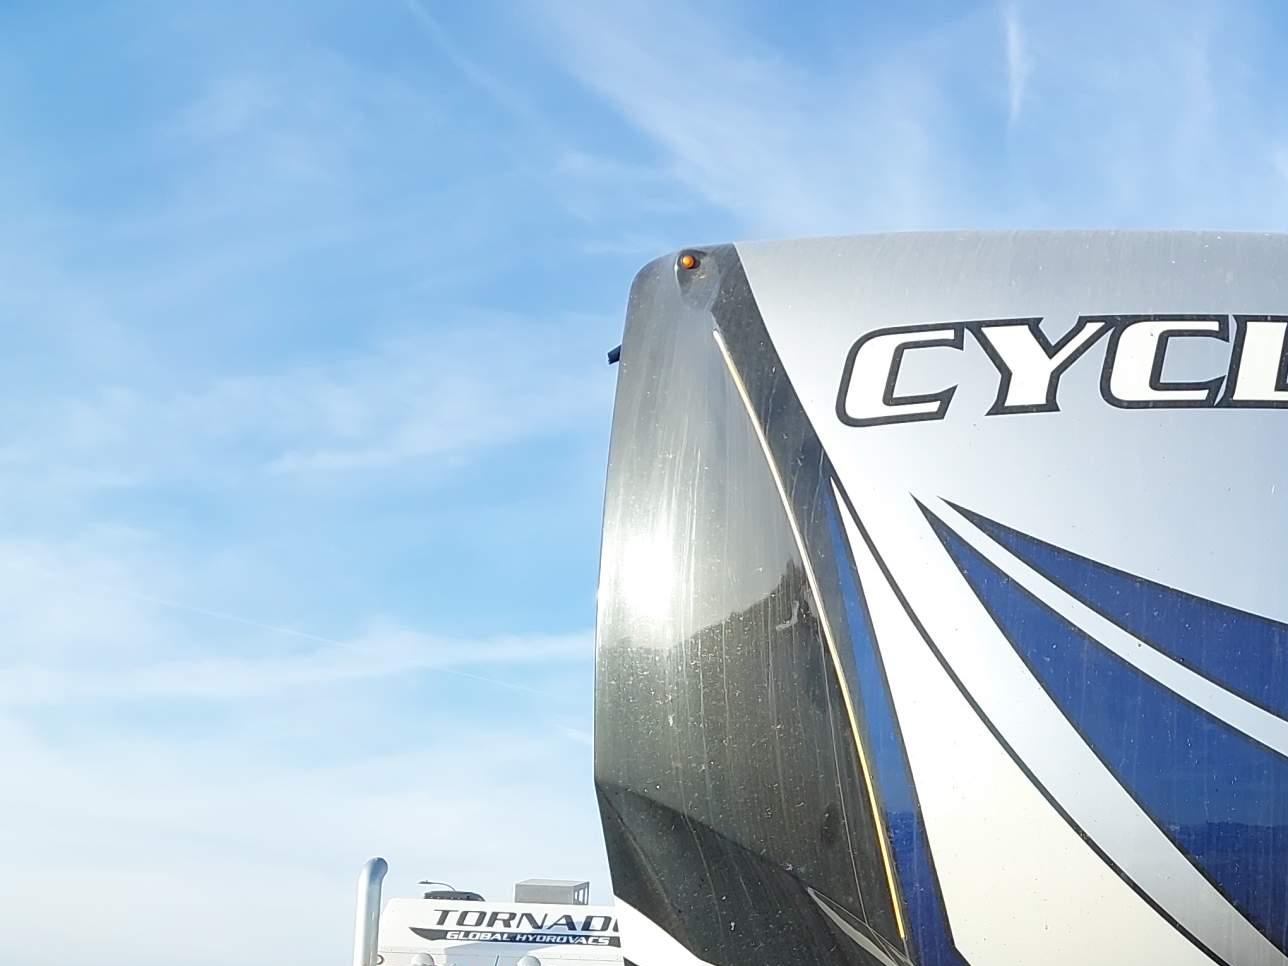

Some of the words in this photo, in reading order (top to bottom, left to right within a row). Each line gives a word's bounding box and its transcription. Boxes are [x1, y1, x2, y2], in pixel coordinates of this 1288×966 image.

[434, 909, 619, 932] TORNAD
[446, 931, 511, 941] GLOBAL
[515, 933, 610, 945] HYDROVACS
